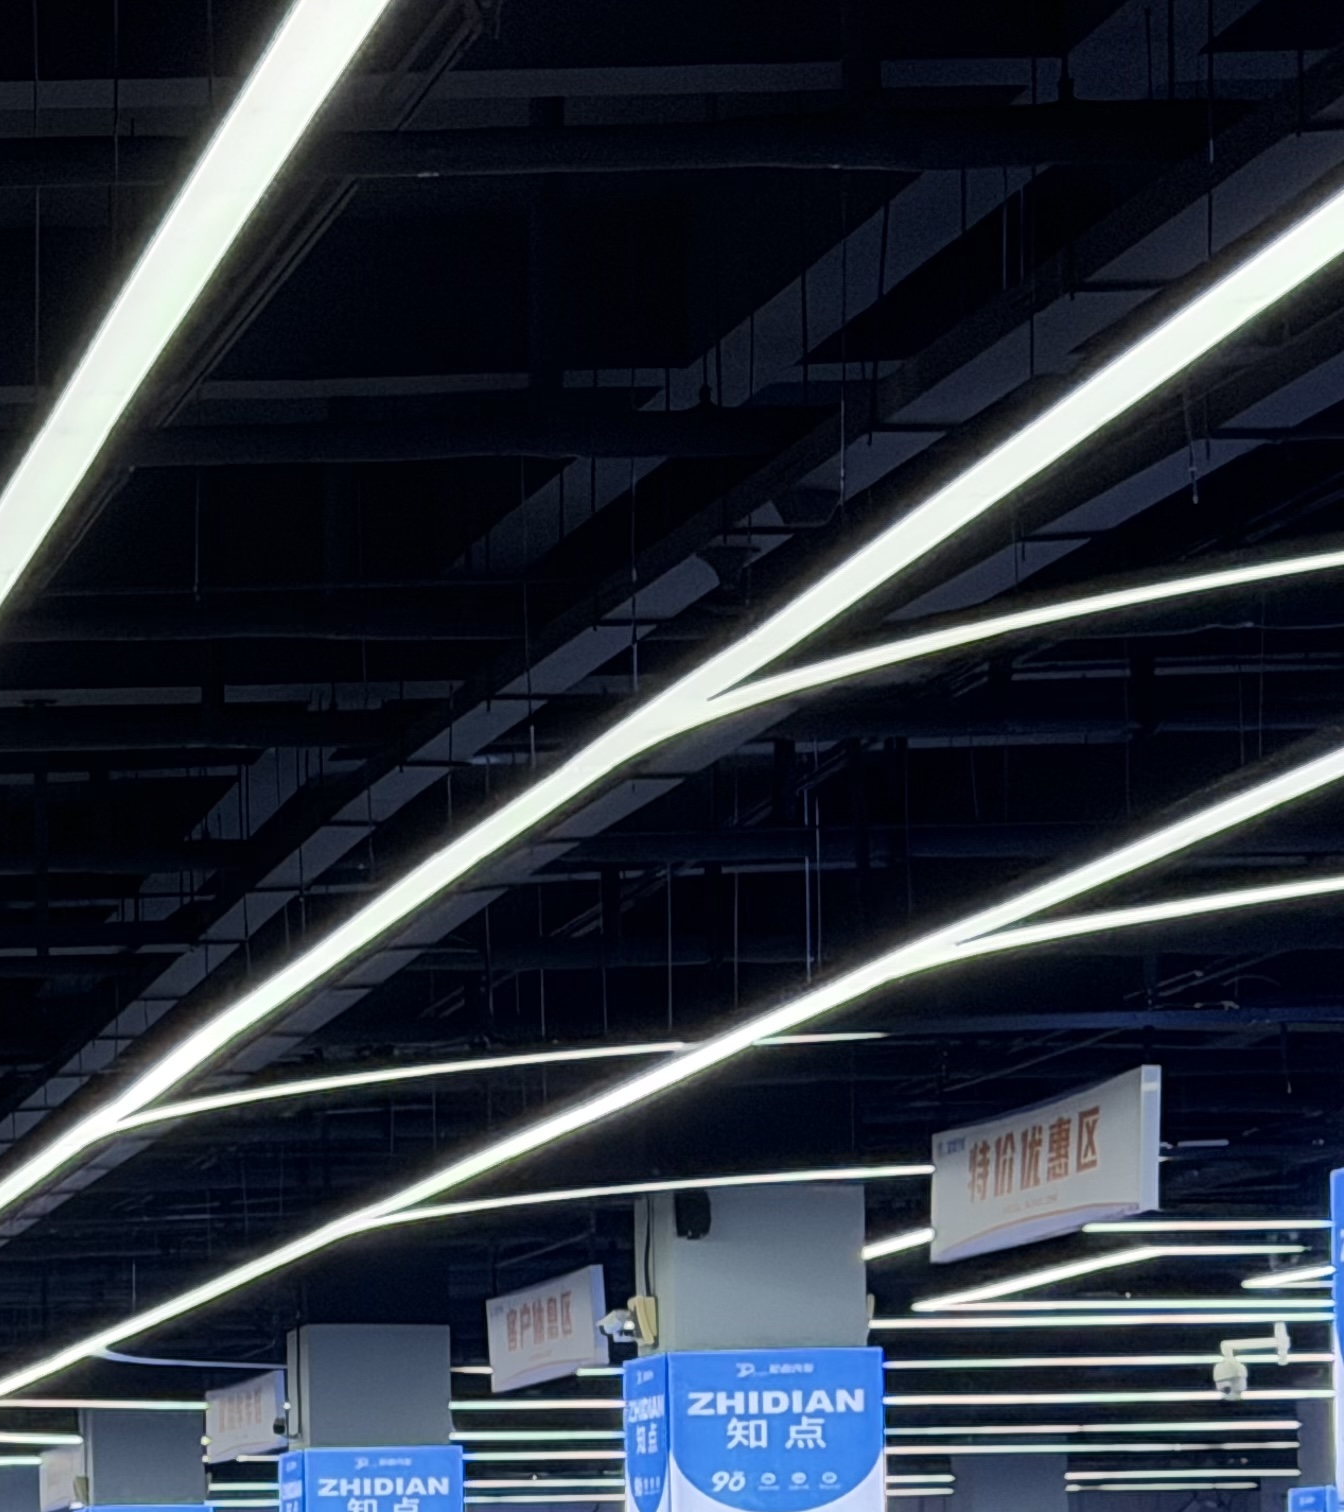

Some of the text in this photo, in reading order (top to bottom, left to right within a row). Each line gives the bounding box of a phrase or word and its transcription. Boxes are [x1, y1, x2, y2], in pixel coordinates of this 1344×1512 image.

[968, 1105, 1100, 1202] 特价优惠区
[688, 1389, 865, 1416] ZHIDIAN
[727, 1416, 826, 1449] 知点
[318, 1477, 449, 1497] ZHIDIAN
